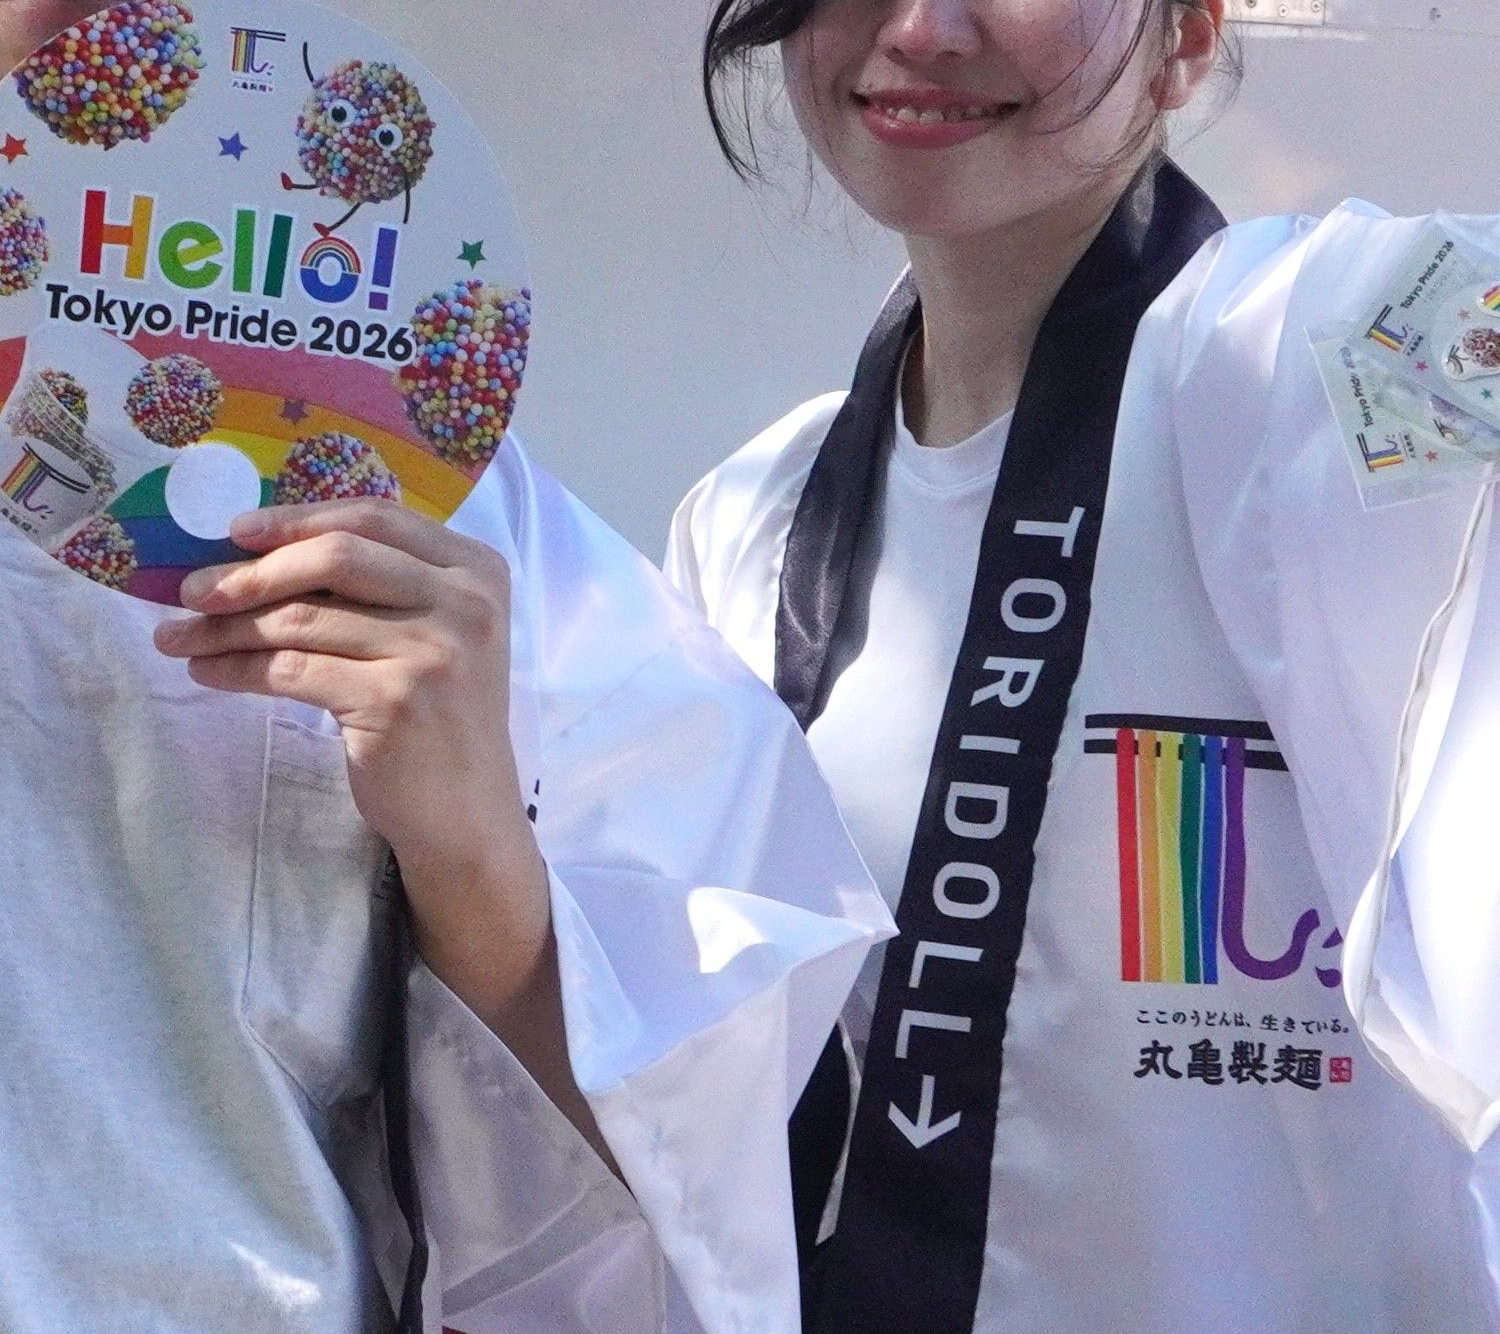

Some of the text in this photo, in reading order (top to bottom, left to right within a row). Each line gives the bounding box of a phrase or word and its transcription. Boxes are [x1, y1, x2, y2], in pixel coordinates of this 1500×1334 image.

[80, 188, 398, 311] Hello!
[46, 283, 414, 362] Tokyo Pride 2026
[1400, 285, 1423, 309] Tokyo
[894, 505, 1086, 1060] TORIDOLL
[1133, 1038, 1323, 1091] 丸亀製麺
